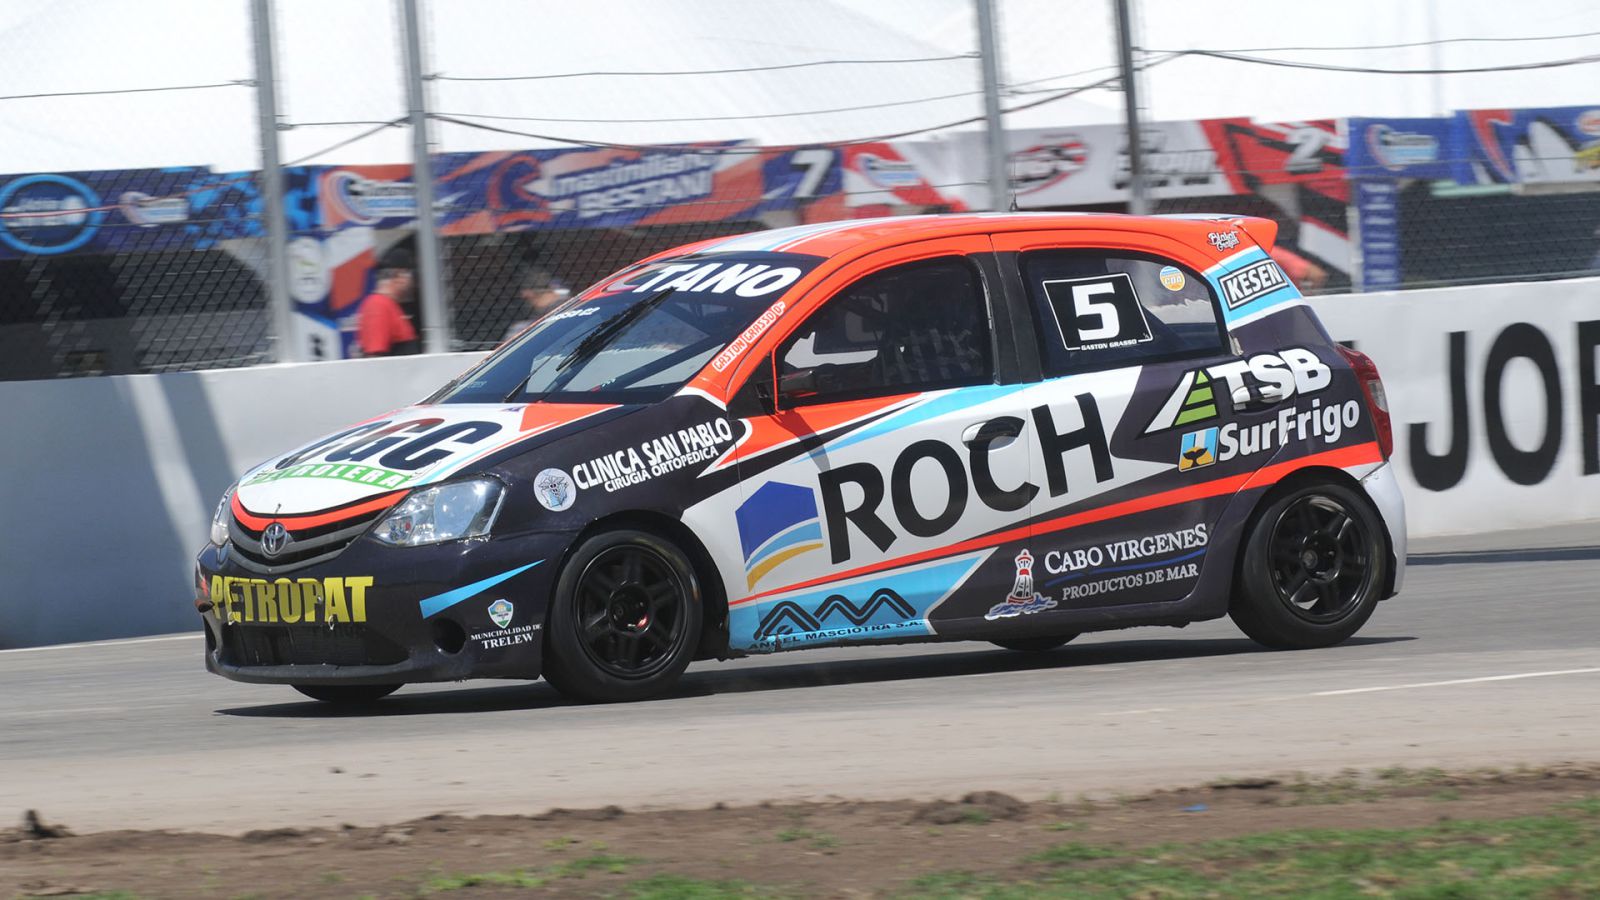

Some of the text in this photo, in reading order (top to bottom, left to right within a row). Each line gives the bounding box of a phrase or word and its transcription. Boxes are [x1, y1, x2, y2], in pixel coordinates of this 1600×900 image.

[789, 149, 832, 200] 7
[632, 262, 801, 298] TANO
[1226, 263, 1283, 302] KESEN
[1072, 282, 1120, 341] 5
[714, 339, 746, 370] GASTON
[744, 312, 776, 342] GRASSO
[1081, 339, 1137, 351] GASTON GRASSO
[1206, 348, 1332, 411] TSB
[572, 417, 733, 490] CLINICA SAN PABLO
[1219, 398, 1360, 461] SurFrigo
[604, 445, 719, 492] CIRUGIA ORTOPEDICA
[818, 392, 1114, 565] ROCH
[1044, 523, 1208, 574] CABO VIRGENES
[210, 575, 374, 624] PETROPAT
[1062, 563, 1199, 600] PRODUCTOS DE MAR
[470, 623, 543, 641] MUNICIPALIDAD DE
[481, 632, 534, 650] TRELEW
